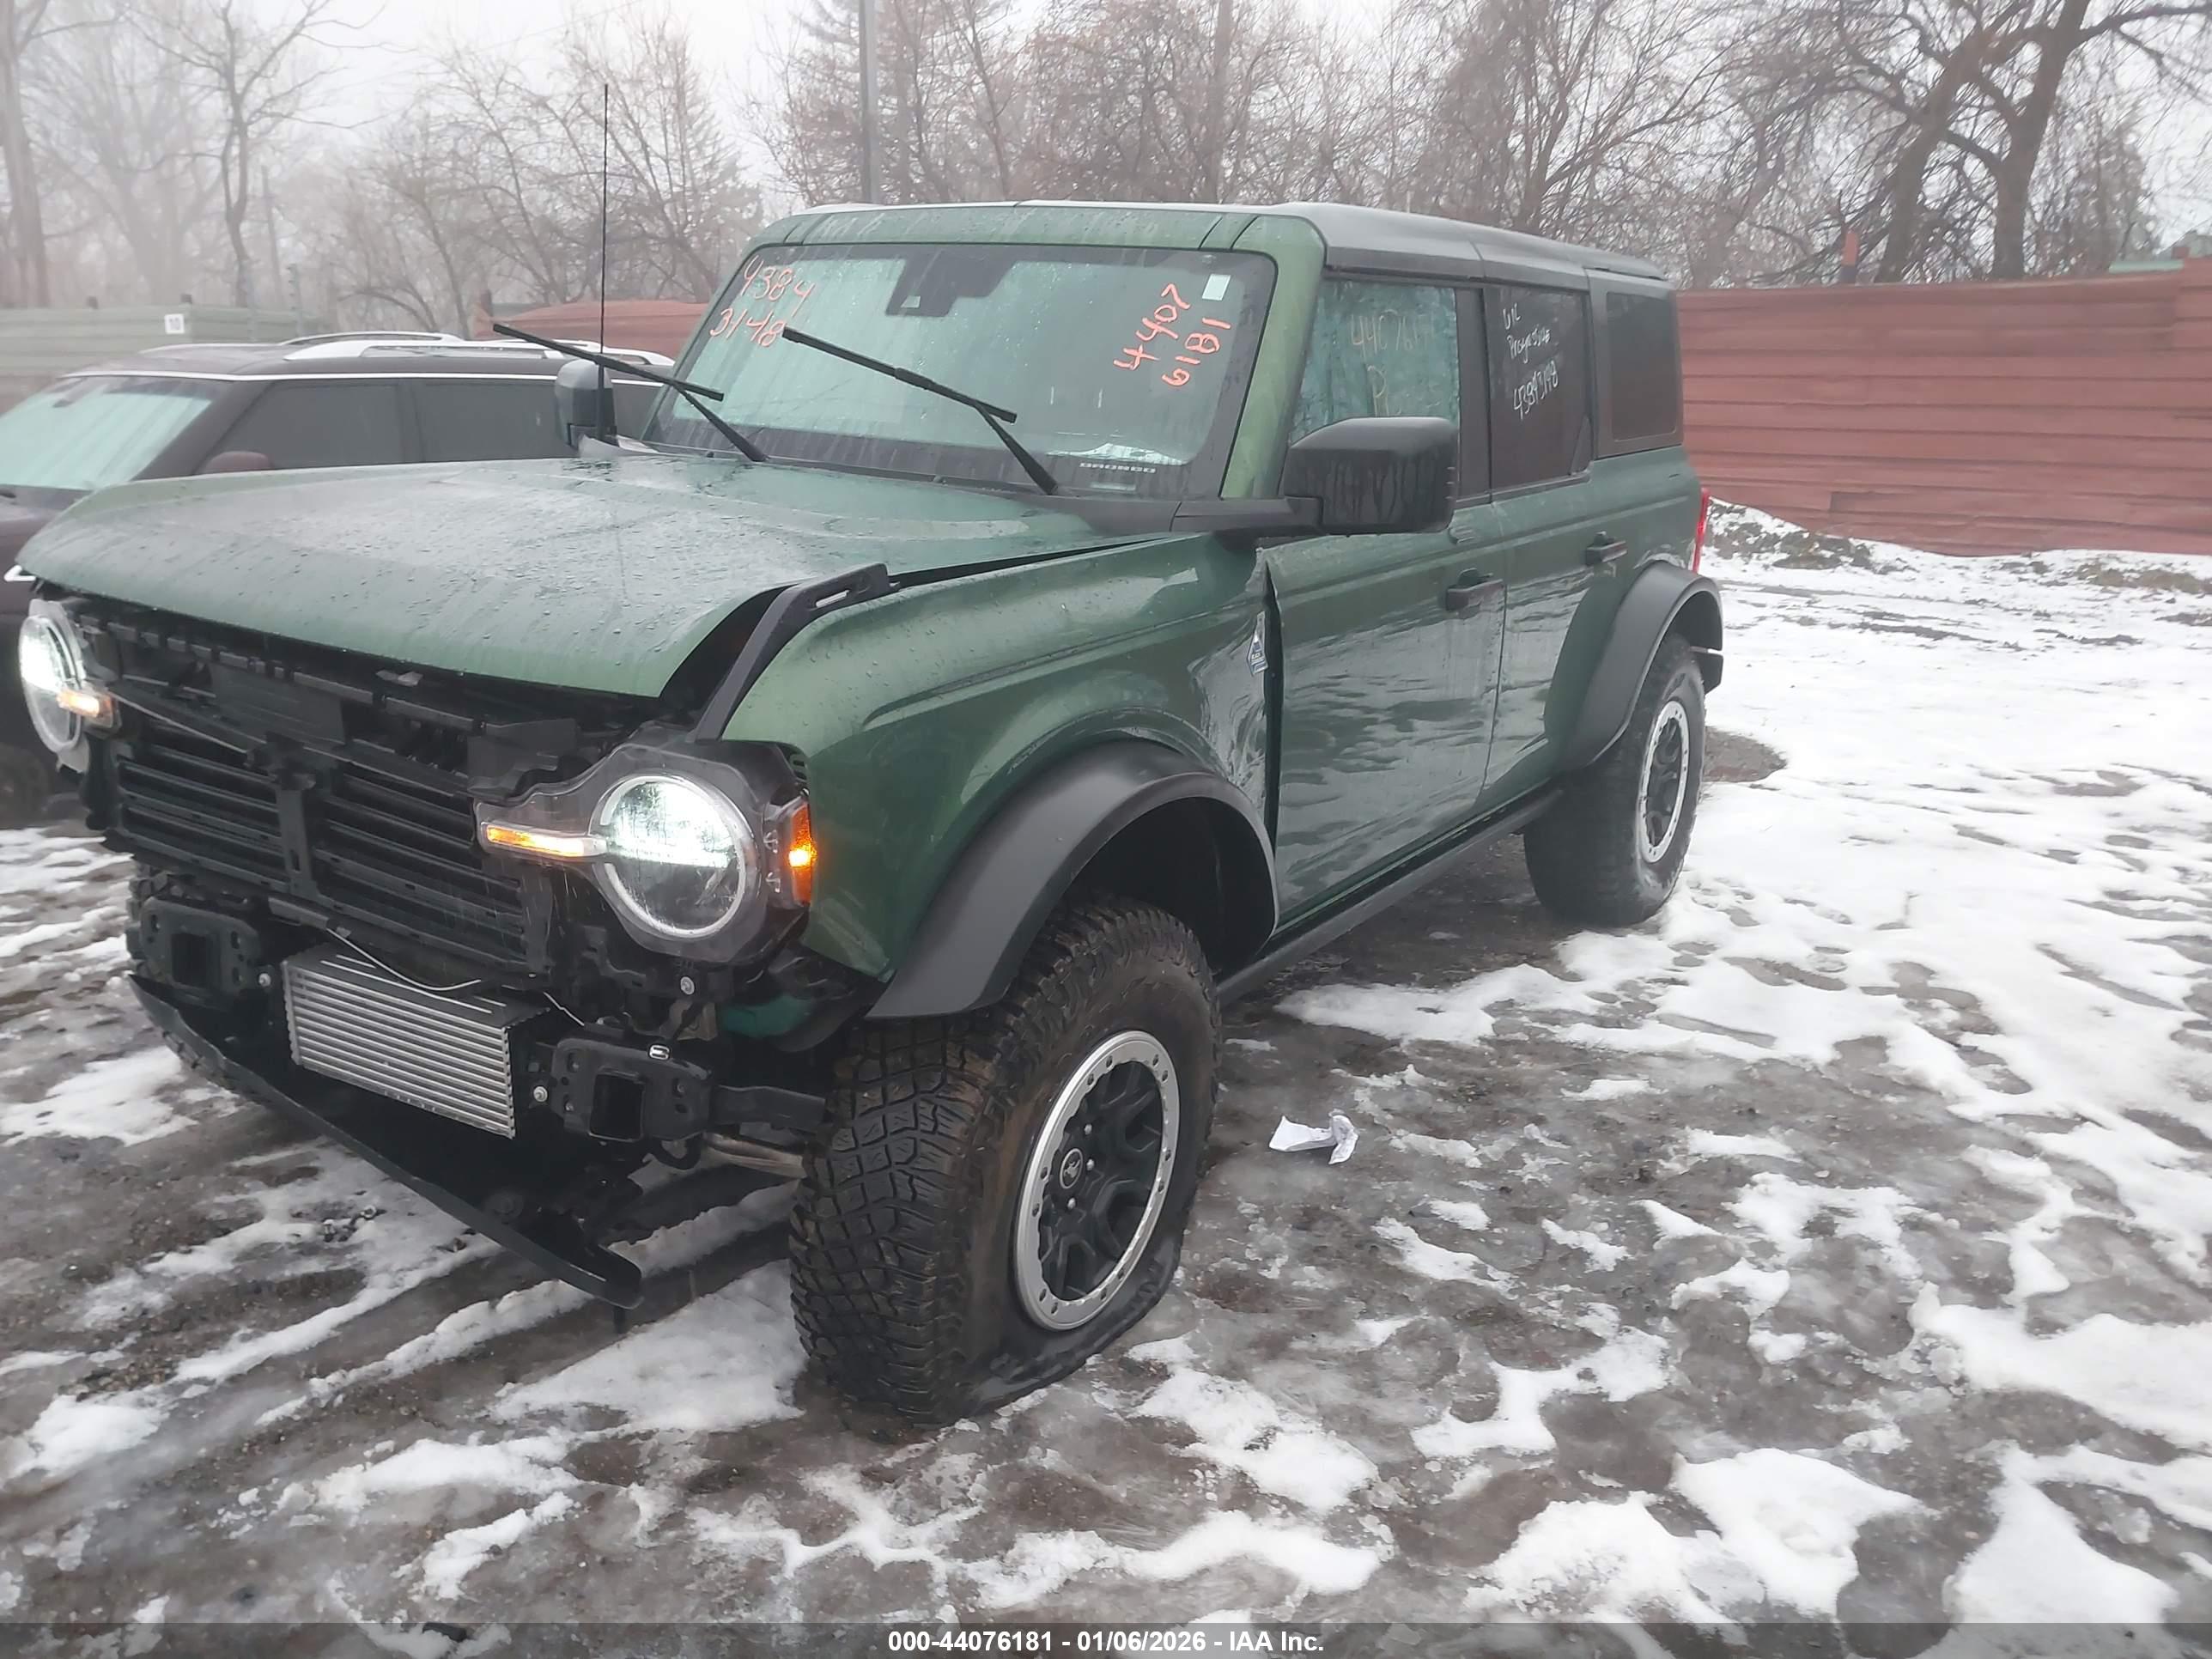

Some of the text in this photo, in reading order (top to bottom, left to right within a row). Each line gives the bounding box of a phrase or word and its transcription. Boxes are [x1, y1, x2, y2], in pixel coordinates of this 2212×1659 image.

[740, 255, 816, 318] 4384
[709, 307, 786, 348] 3148
[1113, 283, 1191, 371] 4407
[1162, 317, 1232, 386] 6181
